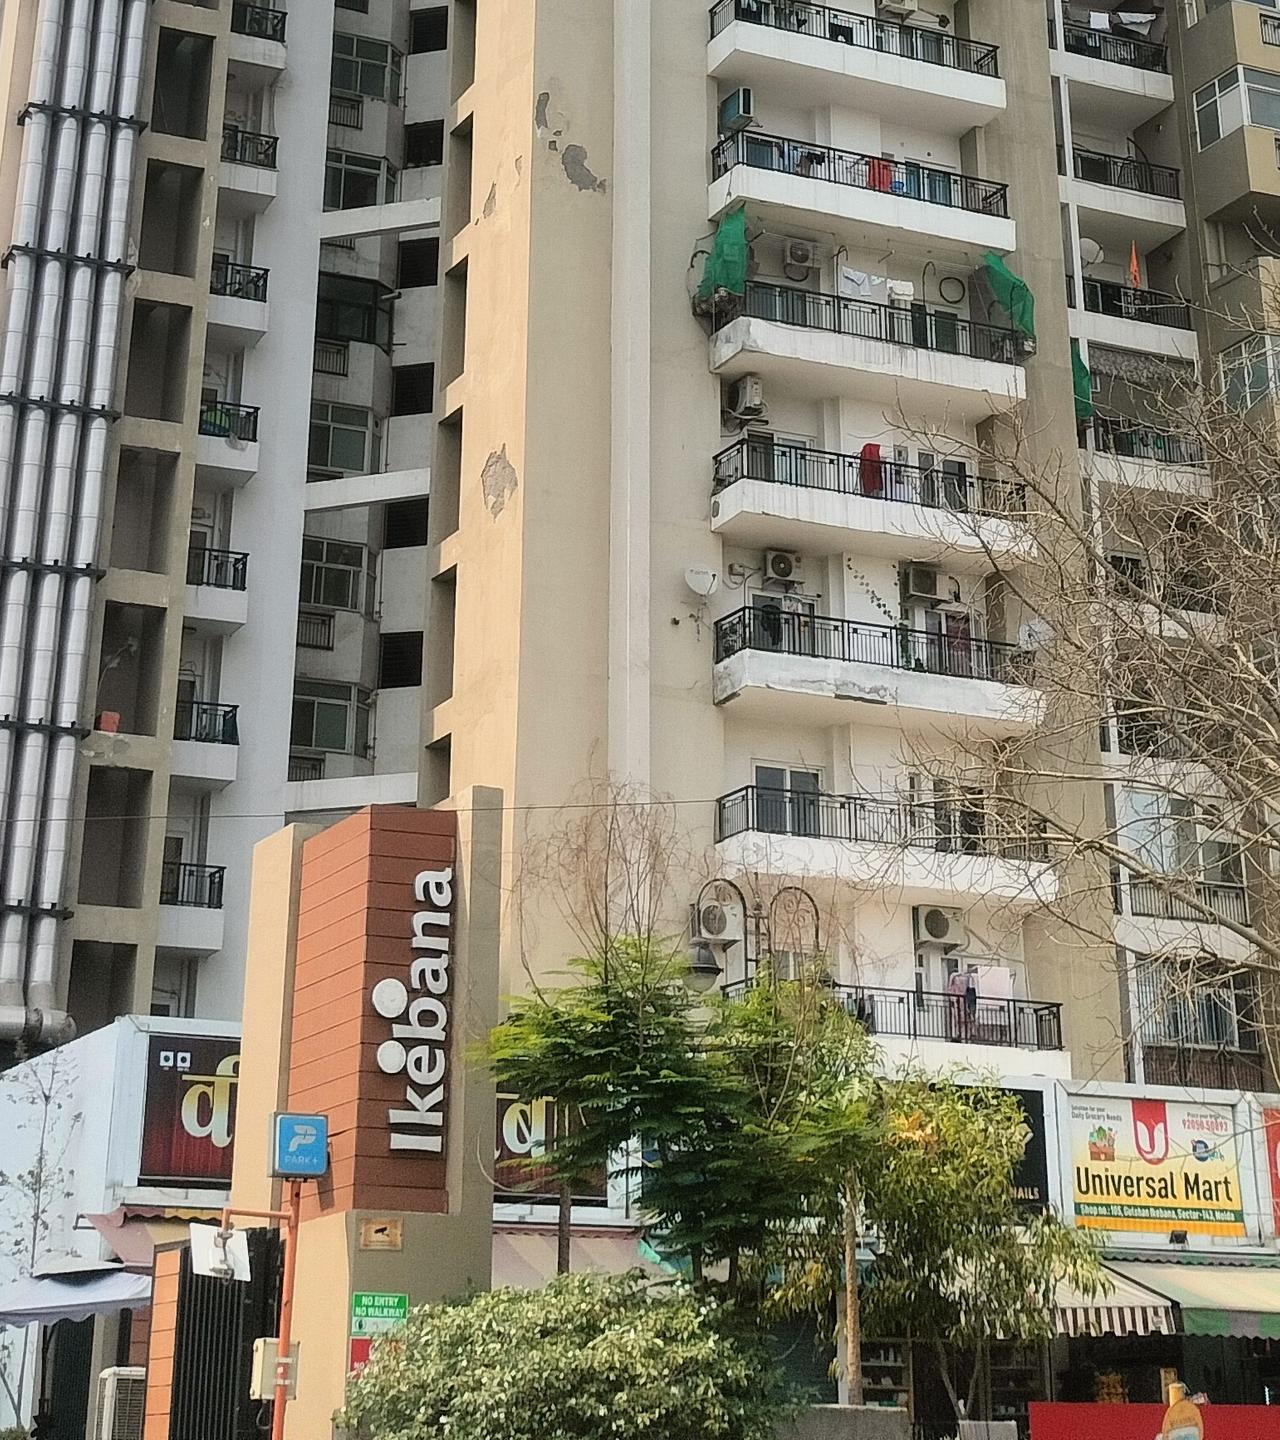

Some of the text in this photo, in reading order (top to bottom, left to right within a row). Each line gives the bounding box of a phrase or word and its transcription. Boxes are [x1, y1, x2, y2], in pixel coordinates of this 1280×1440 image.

[388, 867, 455, 1153] Ikebana
[1076, 1166, 1233, 1202] Universal Mart
[1080, 1204, 1098, 1216] Shop
[361, 1295, 400, 1307] NO ENTRY
[355, 1306, 405, 1317] NO WALKWAY
